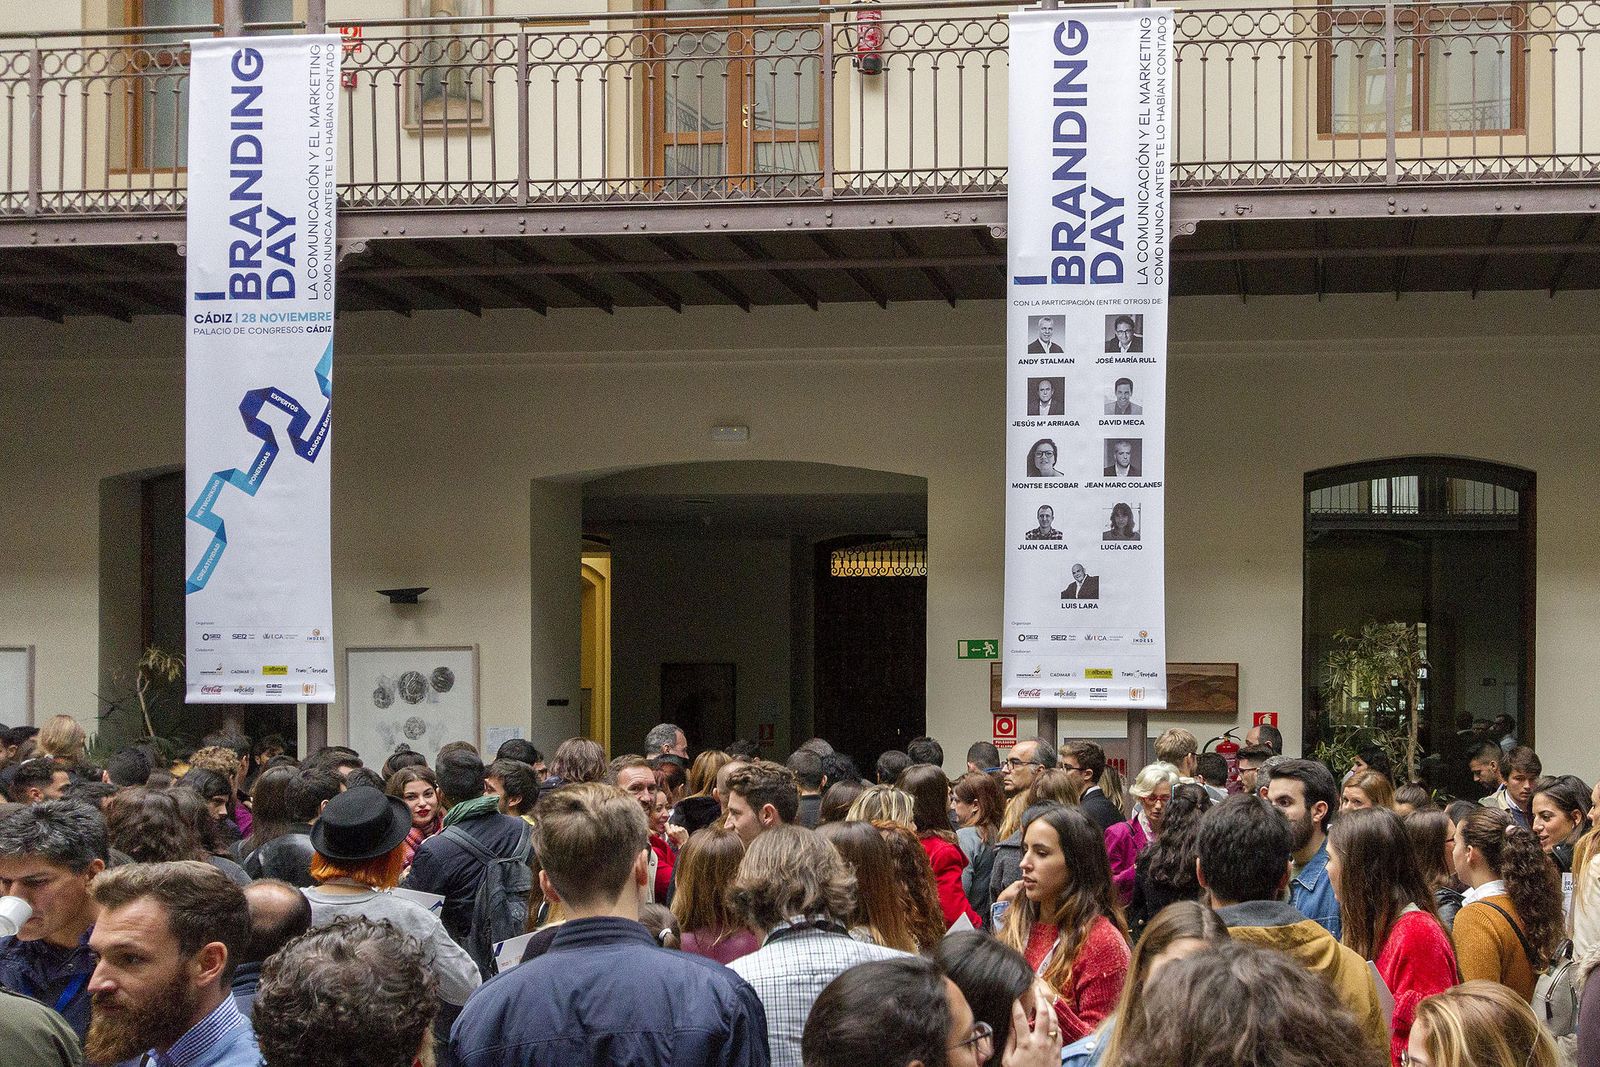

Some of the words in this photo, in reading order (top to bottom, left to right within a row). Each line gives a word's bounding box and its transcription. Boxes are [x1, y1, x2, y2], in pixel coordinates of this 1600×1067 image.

[1140, 17, 1151, 104] MARKETING
[1157, 16, 1166, 75] CONTADO
[309, 45, 320, 127] MARKETING
[326, 43, 334, 100] CONTADO
[1139, 108, 1150, 125] EL
[1155, 78, 1165, 121] HABÍAN
[309, 131, 320, 147] EL
[324, 103, 333, 143] HABÍAN
[1139, 130, 1149, 139] Y
[1156, 125, 1165, 140] LO
[309, 152, 319, 160] Y
[326, 147, 333, 162] LO
[1051, 20, 1089, 285] BRANDING
[1156, 144, 1164, 157] TE
[229, 48, 264, 300] BRANDING
[325, 165, 333, 178] TE
[1156, 160, 1164, 198] ANTES
[306, 165, 319, 279] COMUNICACIÓN
[1136, 144, 1149, 262] COMUNICACIÓN
[324, 221, 332, 260] NUNCA
[1090, 186, 1125, 284] DAY
[1155, 201, 1164, 244] NUNCA
[266, 206, 296, 299] DAY
[1154, 247, 1163, 285] COMO
[308, 282, 318, 300] LA
[1137, 266, 1148, 284] LA
[194, 312, 232, 324] CÁDIZ
[242, 314, 256, 322] 28
[260, 312, 332, 322] NOVIEMBRE
[248, 326, 304, 334] CONGRESOS
[306, 324, 332, 333] CÁDIZ
[1096, 356, 1113, 364] JOSÉ
[270, 392, 299, 413] EXPERTOS
[307, 435, 321, 456] CASOS
[319, 427, 326, 436] DE
[1012, 419, 1035, 427] JESÚS
[248, 451, 271, 486] PONENCIAS
[195, 480, 220, 518] NETWORKING
[196, 543, 220, 581] CREATIVIDAD
